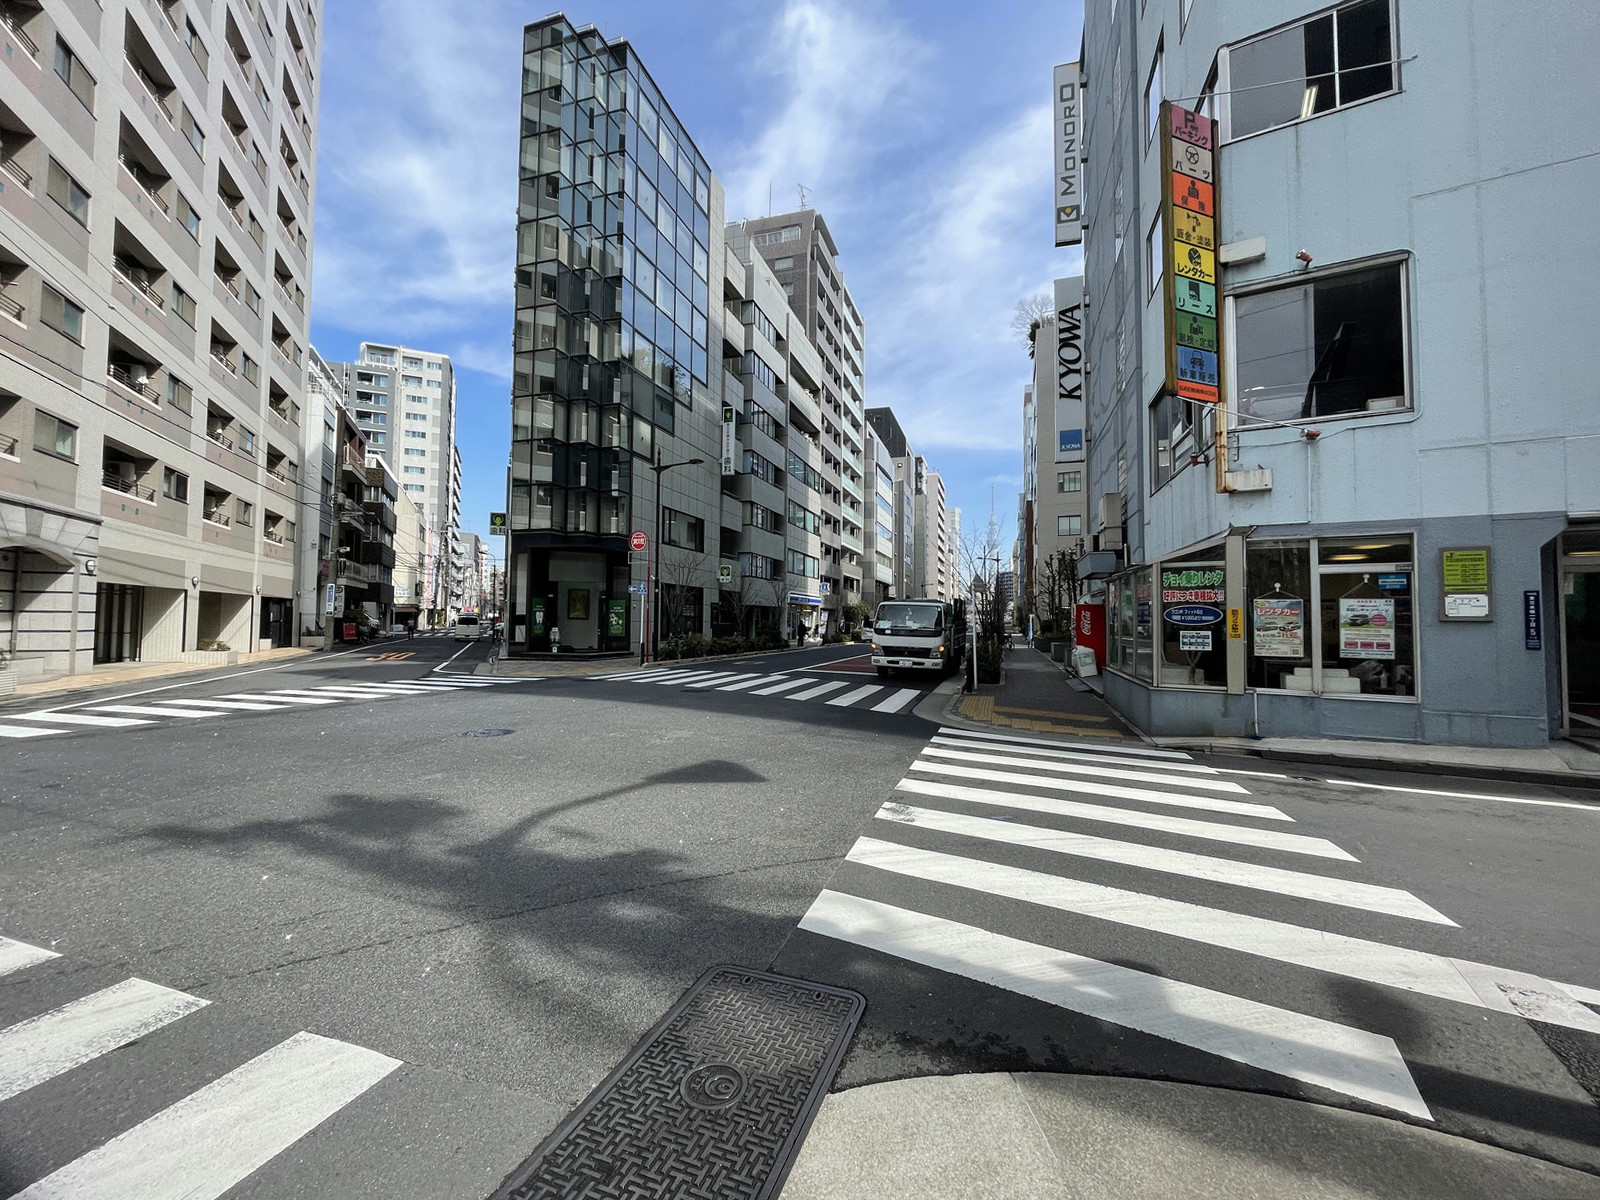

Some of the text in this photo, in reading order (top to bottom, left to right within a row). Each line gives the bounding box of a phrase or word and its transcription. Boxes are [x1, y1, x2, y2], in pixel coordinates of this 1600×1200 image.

[1184, 109, 1196, 129] P
[1174, 125, 1208, 146] パーキング
[1175, 160, 1210, 180] パーツ
[1177, 262, 1213, 279] レンタカー
[1178, 296, 1214, 315] リース
[1057, 302, 1082, 402] KYOWA
[1257, 608, 1300, 616] レンタカー
